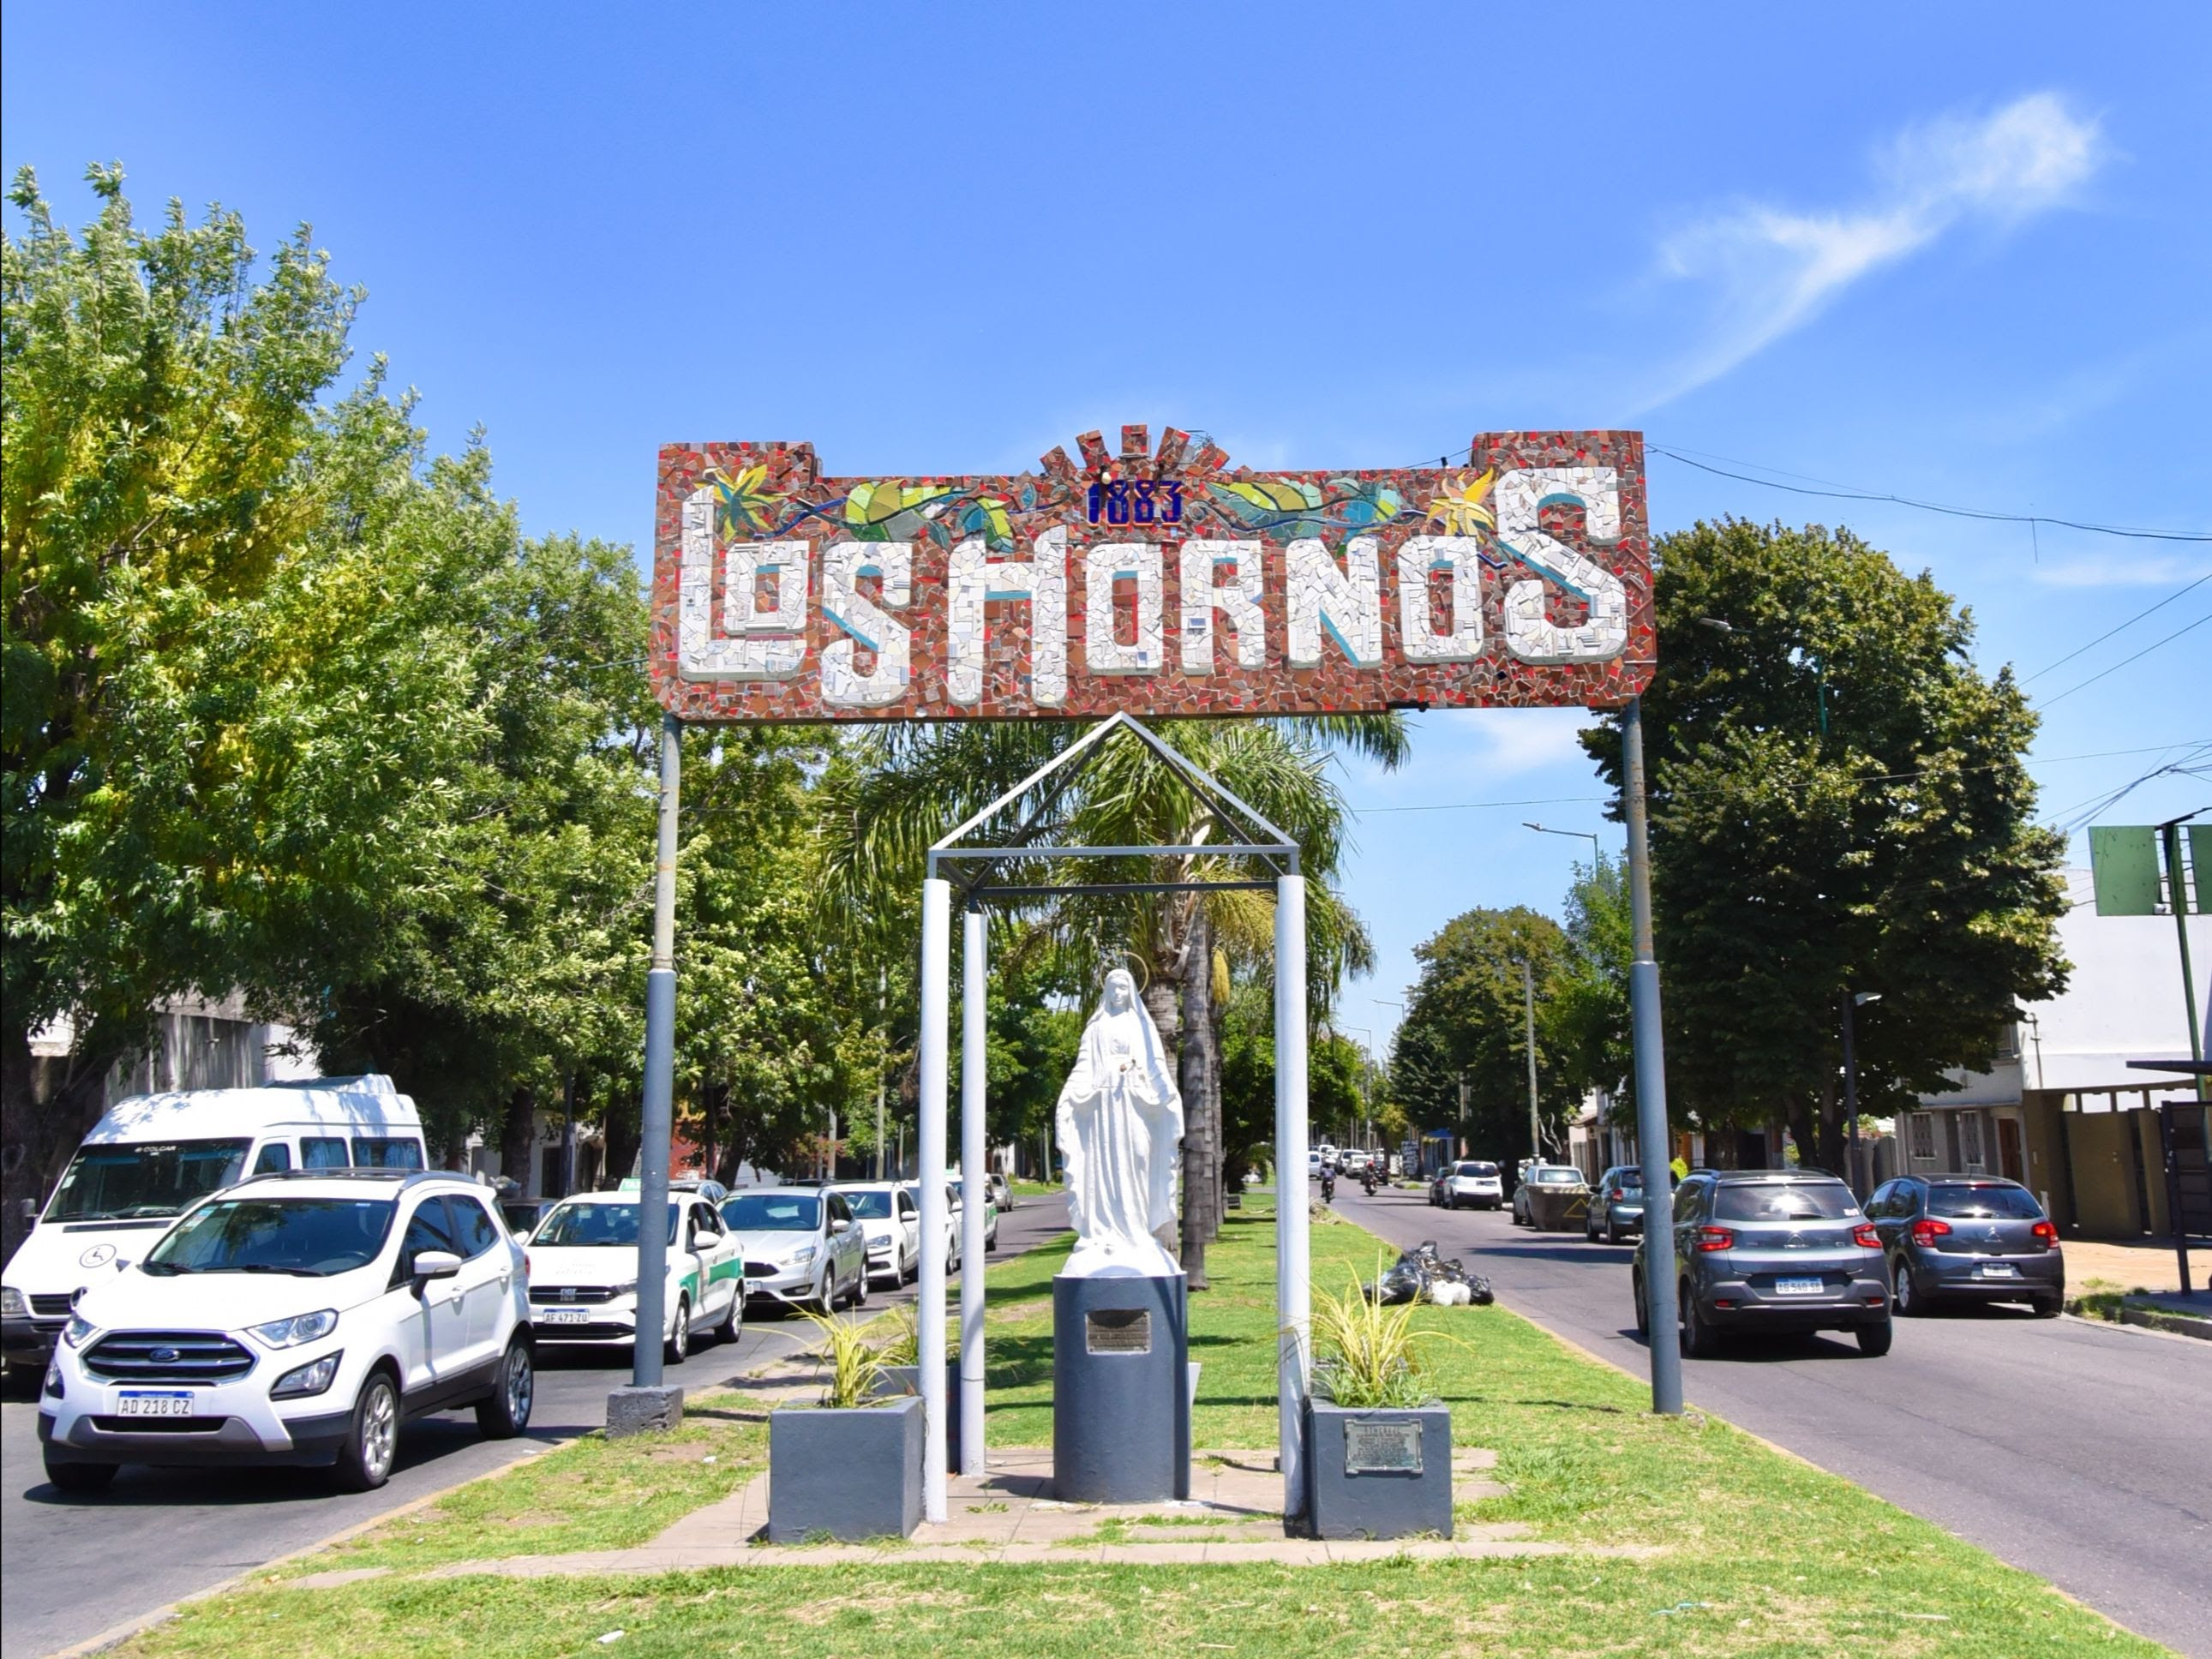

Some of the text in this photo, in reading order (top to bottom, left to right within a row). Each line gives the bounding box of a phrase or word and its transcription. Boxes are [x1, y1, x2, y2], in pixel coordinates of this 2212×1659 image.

[1087, 479, 1184, 525] 1883
[948, 466, 1628, 709] HORNOS
[545, 1313, 556, 1322] AF
[558, 1313, 574, 1322] 471
[121, 1399, 189, 1414] AD 218 CZ
